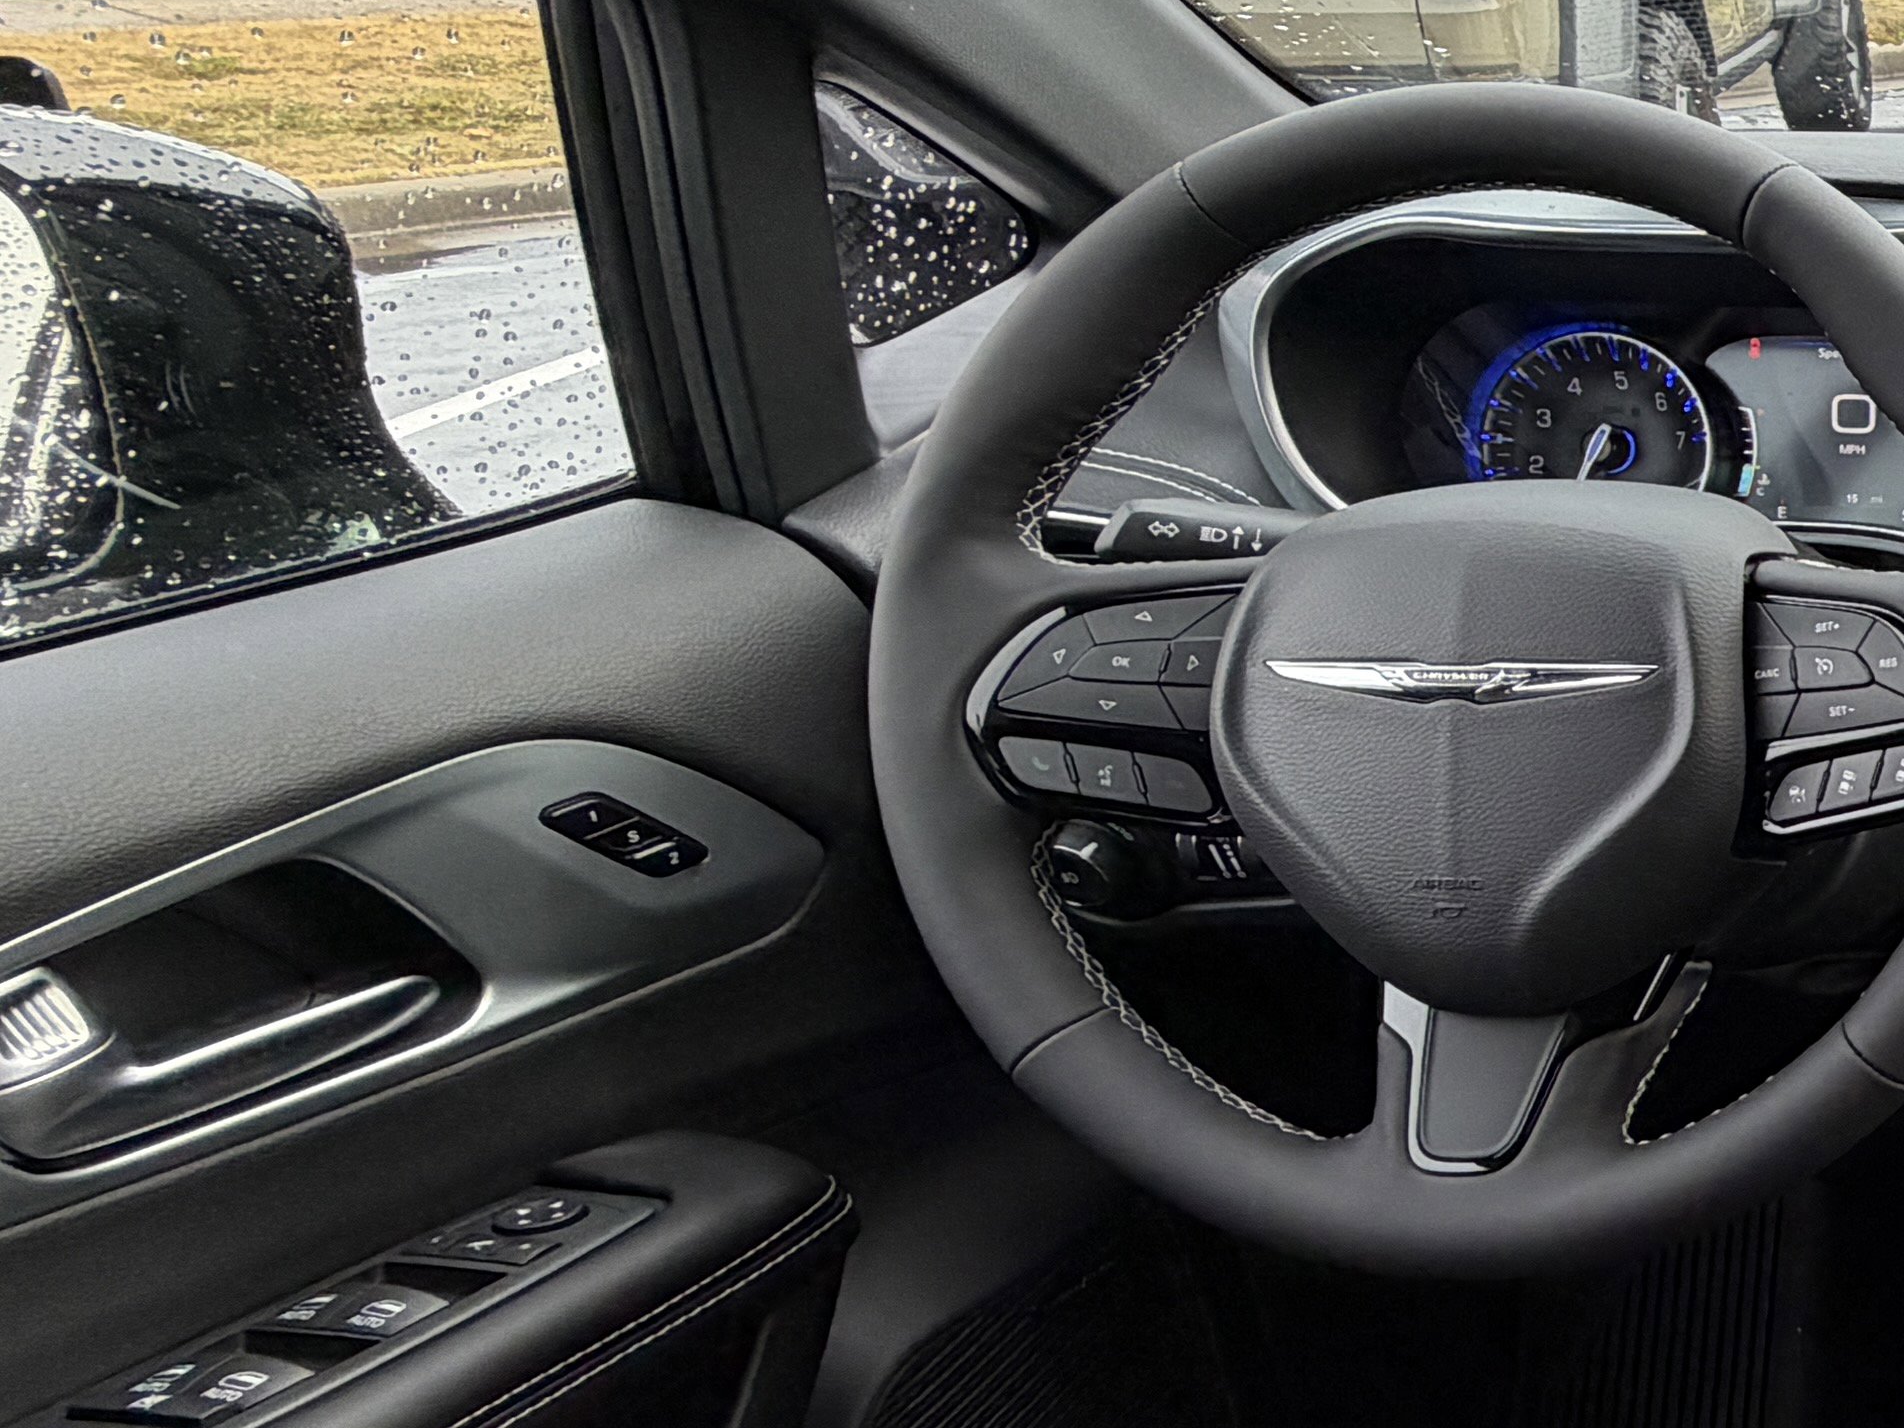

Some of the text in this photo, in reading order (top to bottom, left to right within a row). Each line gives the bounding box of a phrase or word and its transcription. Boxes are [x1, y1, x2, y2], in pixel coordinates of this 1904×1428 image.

[1567, 377, 1583, 397] 4
[1613, 371, 1629, 390] 5
[1654, 392, 1668, 412] 6
[1536, 408, 1552, 428] 3
[1675, 430, 1686, 450] 7
[1838, 444, 1866, 456] MPH
[1528, 455, 1544, 474] 2
[1777, 505, 1787, 519] E
[1814, 620, 1840, 634] SET+
[1111, 655, 1131, 668] OK
[1878, 656, 1899, 669] RES
[1754, 668, 1780, 680] CANC
[626, 830, 640, 843] S
